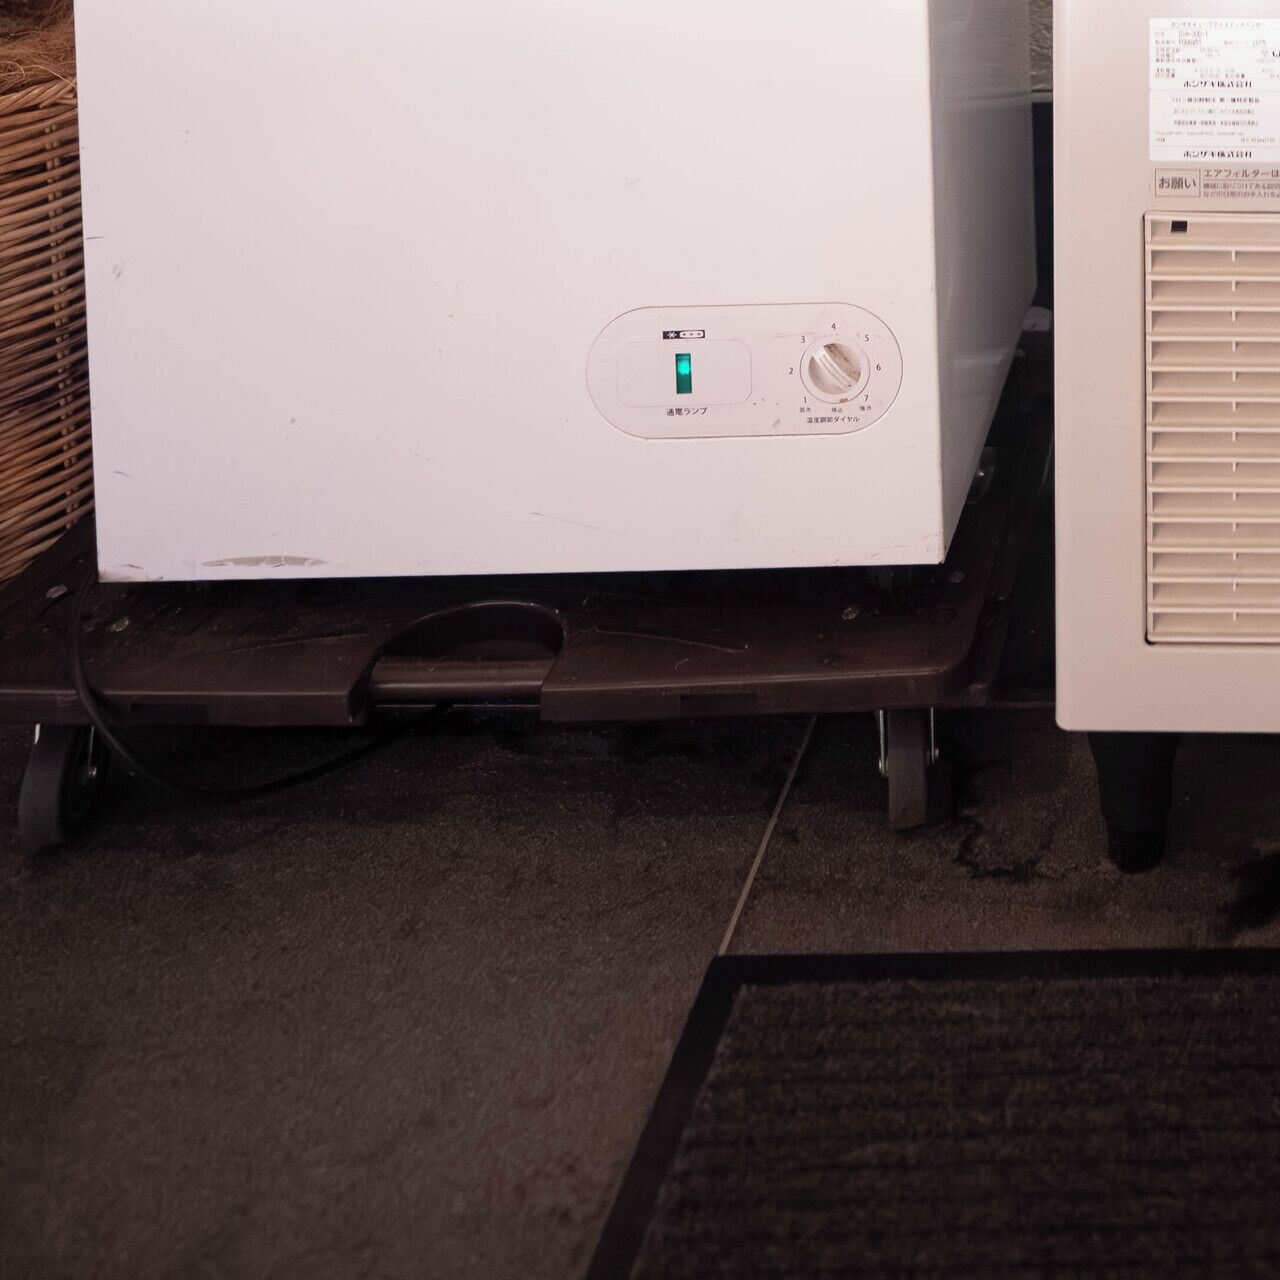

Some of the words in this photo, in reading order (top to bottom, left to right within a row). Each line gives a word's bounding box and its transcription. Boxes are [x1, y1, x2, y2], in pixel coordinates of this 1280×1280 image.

[1158, 176, 1197, 190] お願い
[800, 335, 806, 344] 3
[788, 367, 794, 375] 2
[876, 363, 882, 371] 6
[803, 396, 807, 404] 1
[863, 394, 869, 402] 7
[666, 406, 708, 416] 通電ランプ
